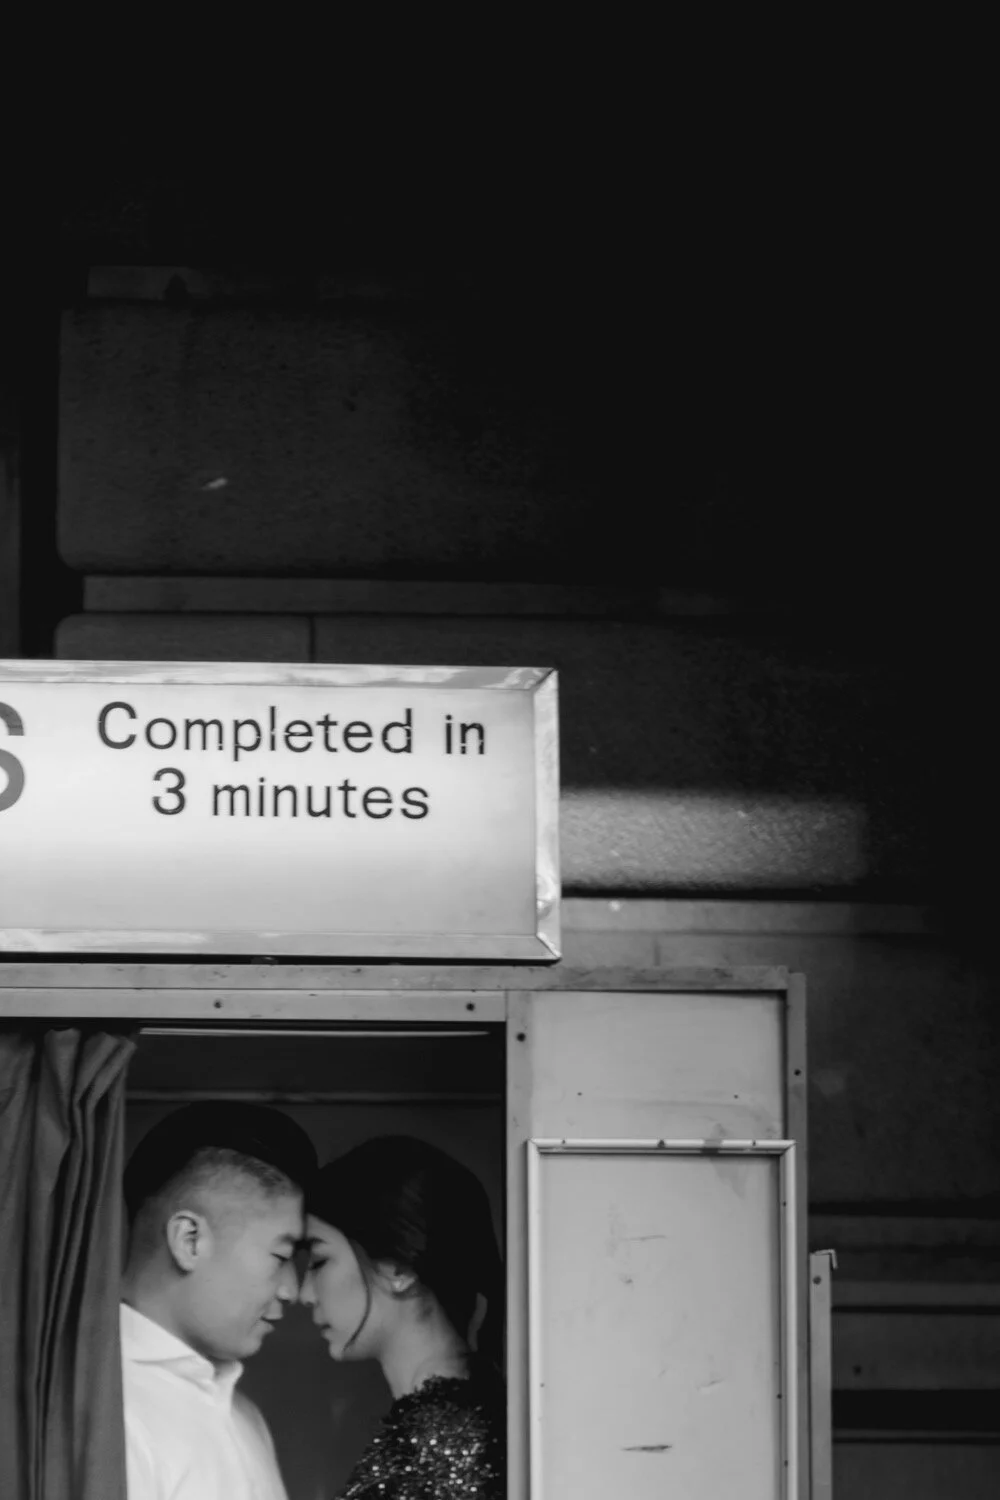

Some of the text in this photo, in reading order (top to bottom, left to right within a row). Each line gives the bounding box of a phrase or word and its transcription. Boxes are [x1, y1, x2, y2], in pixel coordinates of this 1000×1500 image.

[98, 701, 486, 762] Completed in
[151, 766, 430, 820] 3 minutes
